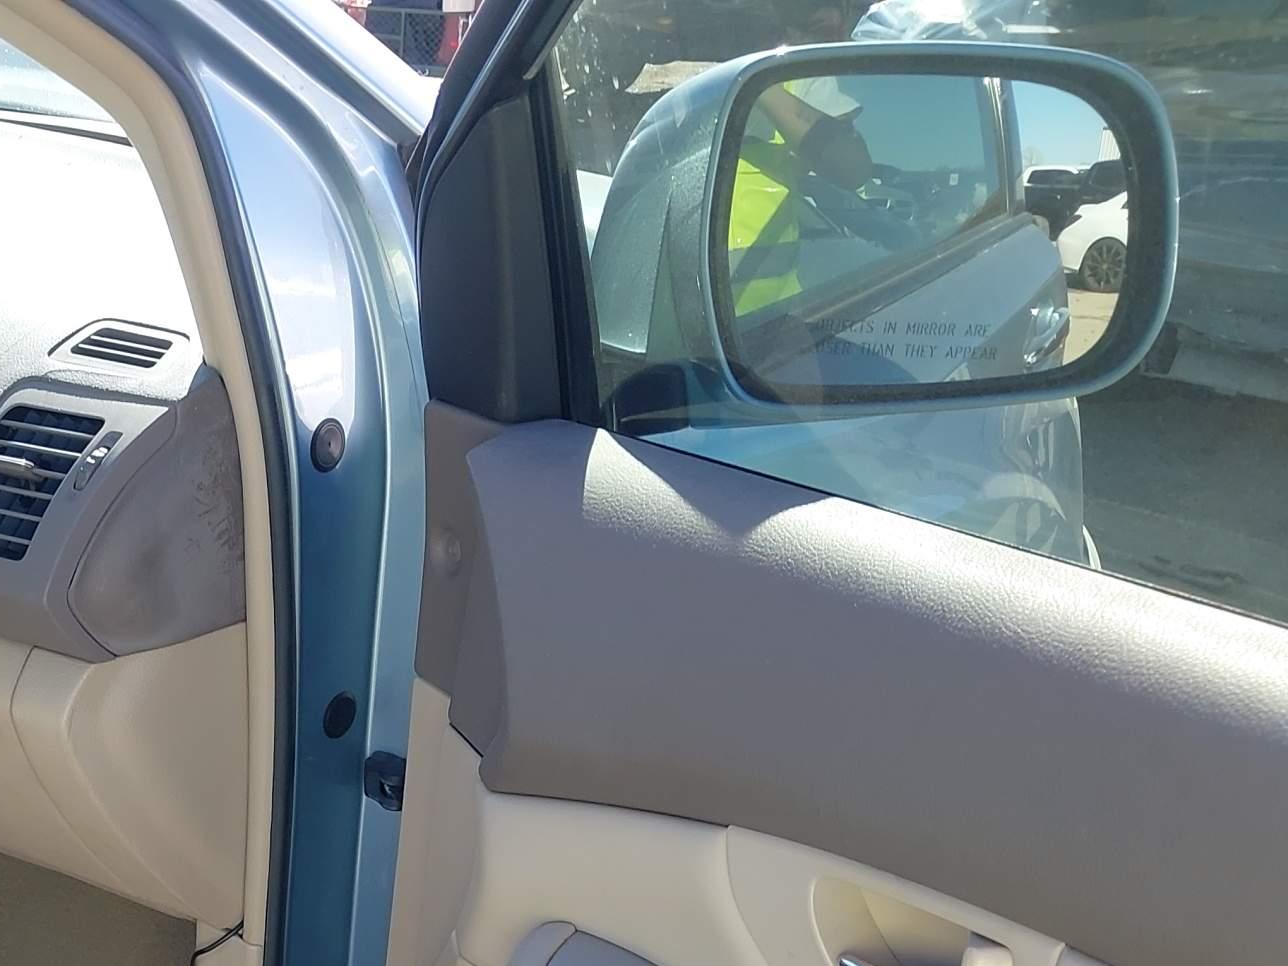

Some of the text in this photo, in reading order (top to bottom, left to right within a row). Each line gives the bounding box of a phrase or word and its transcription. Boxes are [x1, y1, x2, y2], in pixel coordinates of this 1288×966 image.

[882, 320, 897, 334] IN
[904, 320, 957, 336] MIRROR
[963, 322, 992, 337] ARE
[861, 343, 895, 357] THAN
[904, 344, 938, 358] THEY
[944, 346, 999, 360] APPEAR
